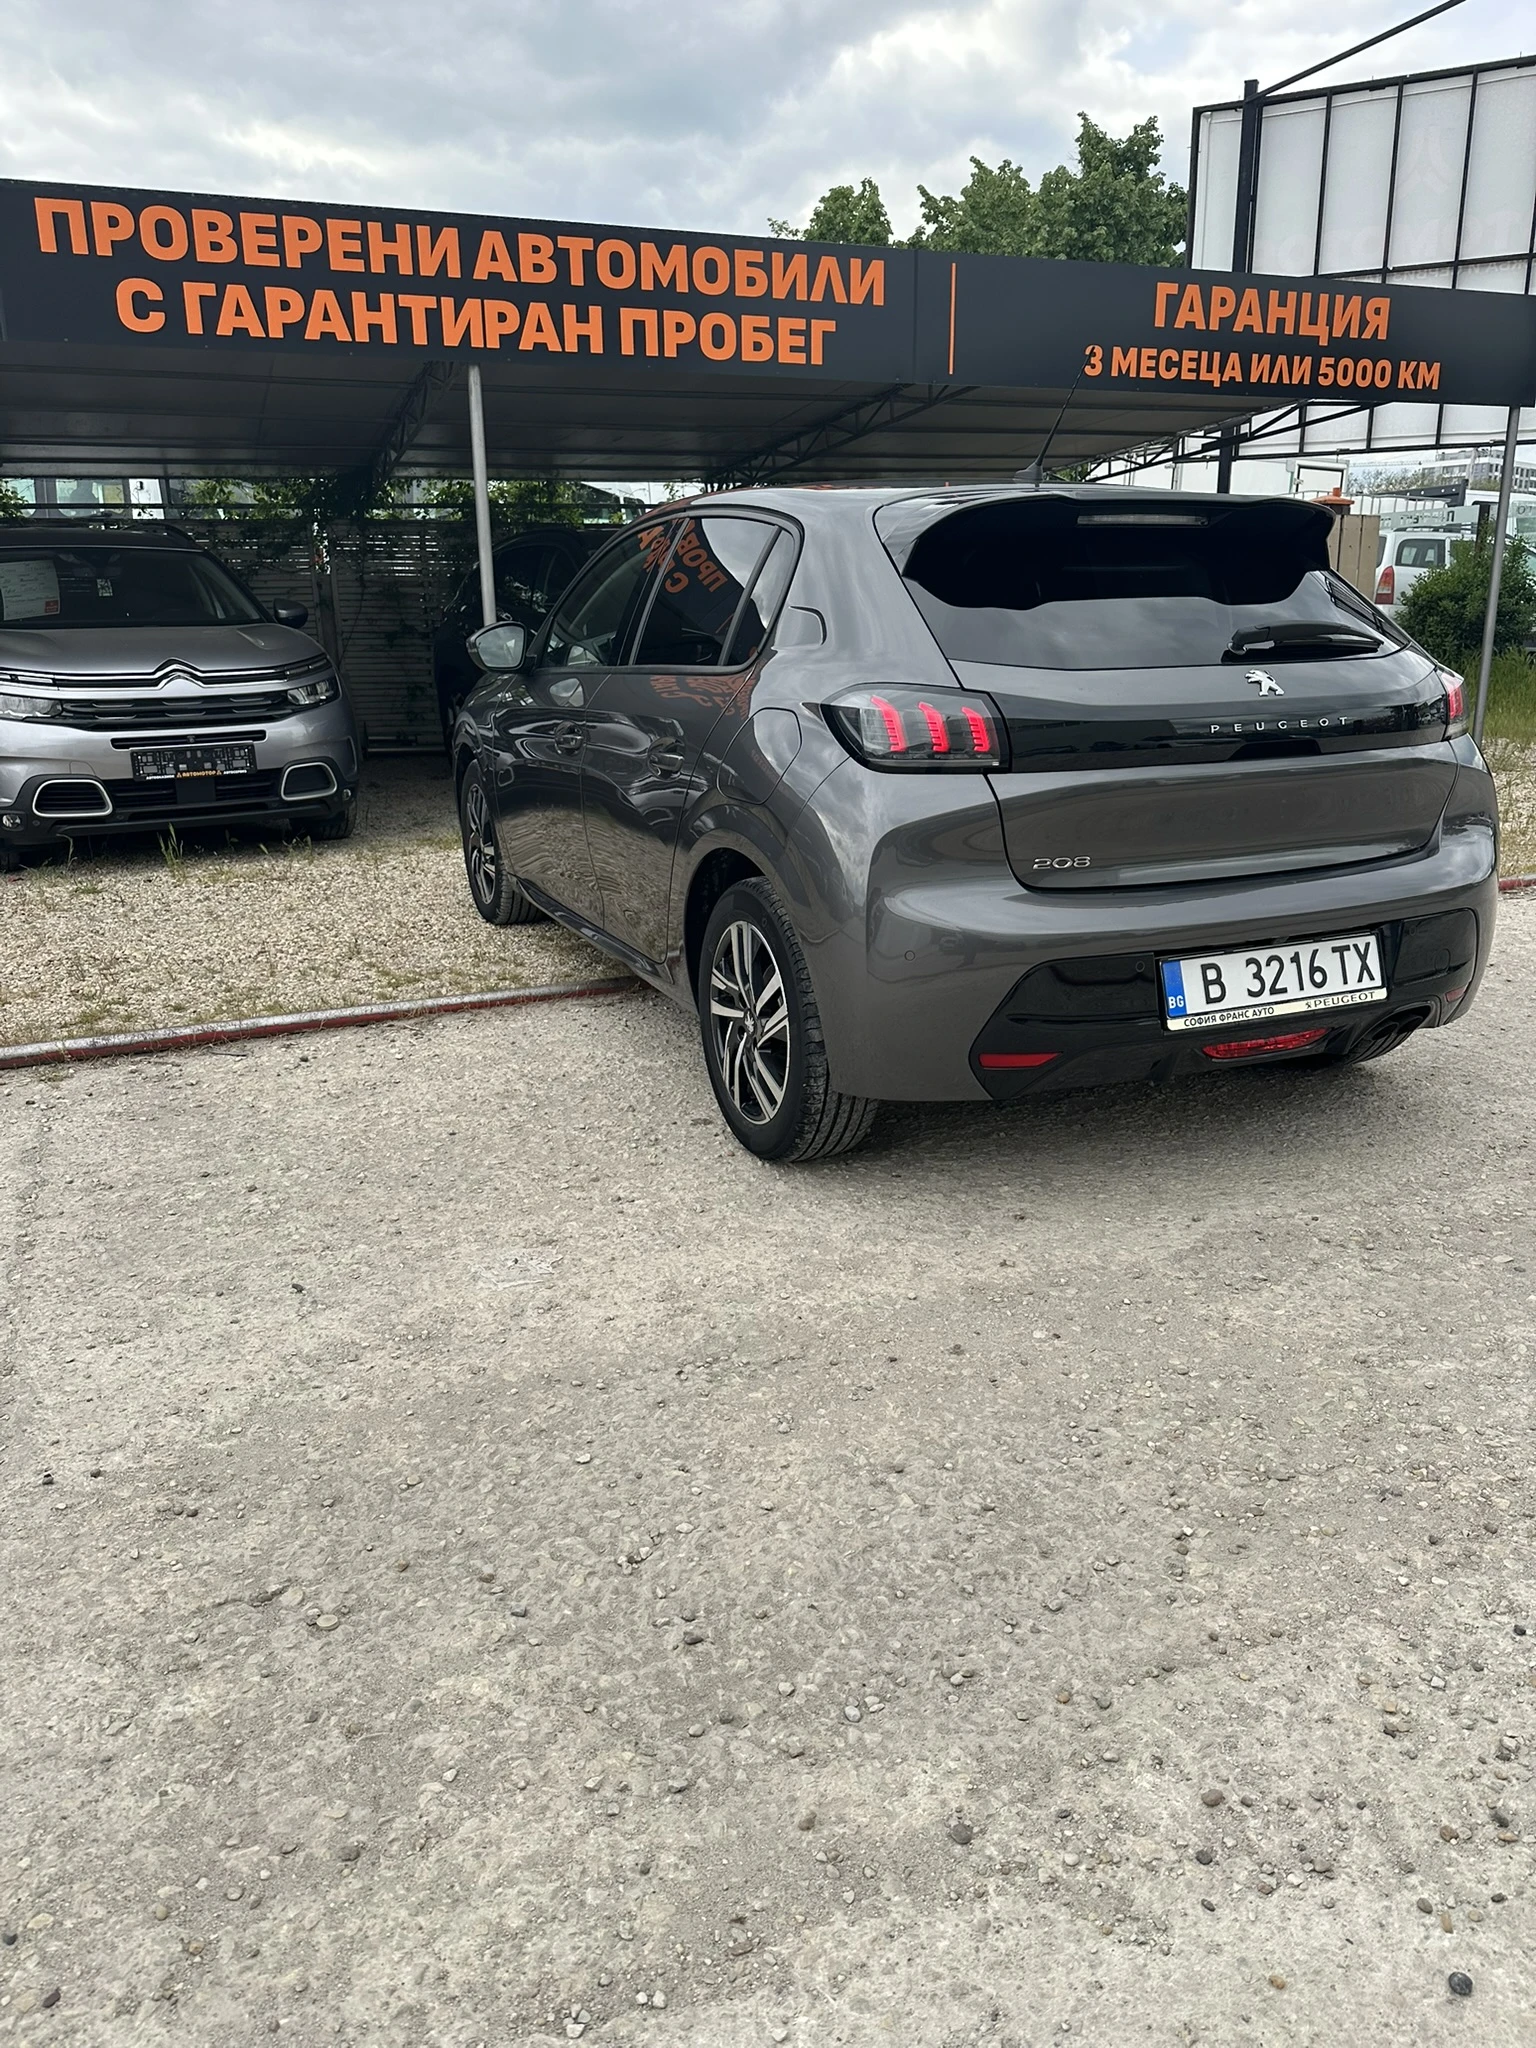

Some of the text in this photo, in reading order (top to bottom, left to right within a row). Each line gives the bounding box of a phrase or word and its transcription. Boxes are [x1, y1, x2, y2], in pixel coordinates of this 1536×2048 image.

[34, 197, 885, 306] ПРОВЕРЕНИ АВТОМОБИЛИ
[115, 278, 837, 365] С ГАРАНТИРАН ПРОБЕГ
[1153, 281, 1390, 346] ГАРАНЦИЯ
[1083, 344, 1441, 390] 3 МЕСЕЦА ИЛИ 5000 КМ
[1209, 715, 1349, 734] PEUGEOT
[1031, 855, 1092, 871] 208
[1199, 961, 1227, 1006] B
[1313, 991, 1376, 1009] PEUGEOT
[1167, 994, 1185, 1010] BG
[1183, 1006, 1275, 1028] СОФИЯ ФРАНС АУТО
